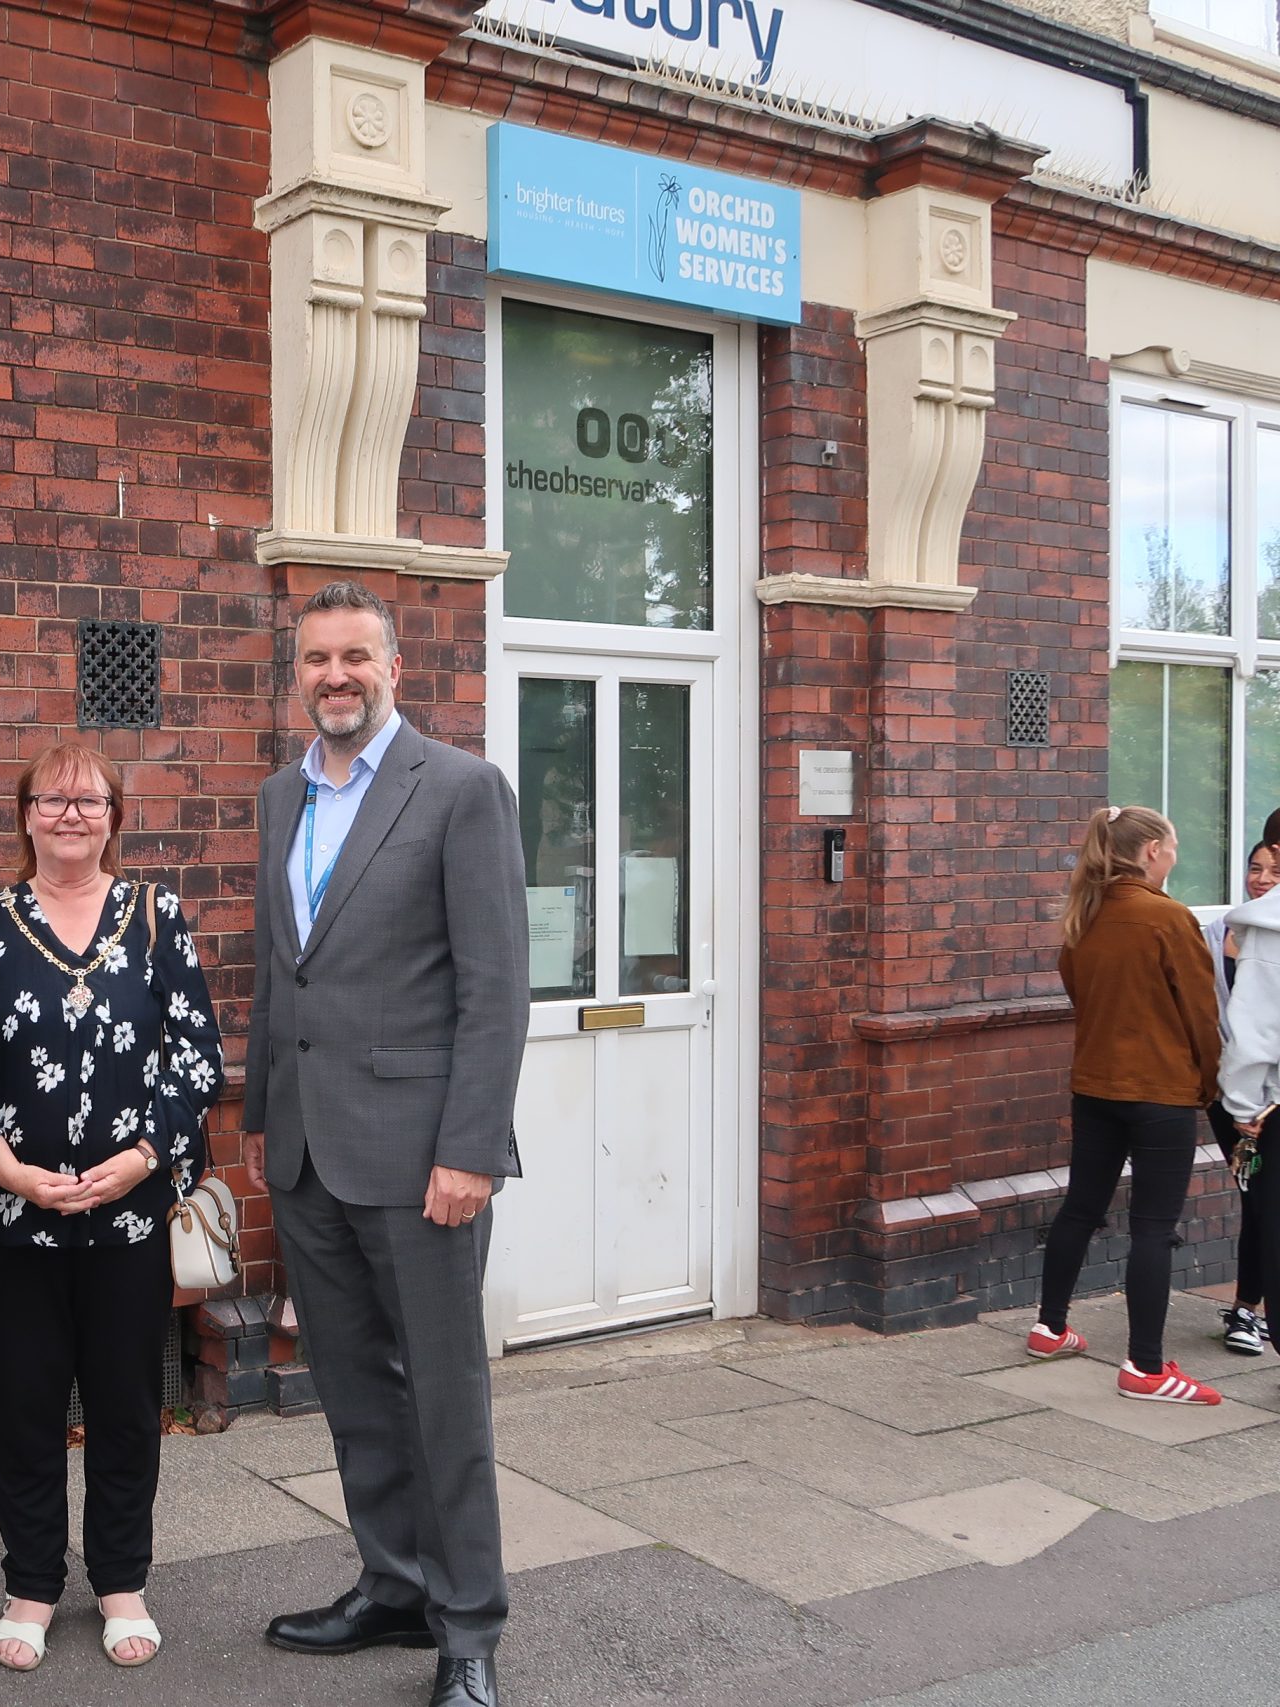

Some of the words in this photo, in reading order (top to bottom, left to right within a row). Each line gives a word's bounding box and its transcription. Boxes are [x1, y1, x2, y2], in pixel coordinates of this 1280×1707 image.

[516, 180, 573, 213] brighter
[576, 194, 625, 225] futures
[688, 186, 775, 229] ORCHID
[676, 216, 787, 265] WOMEN'S
[679, 251, 785, 297] SERVICES
